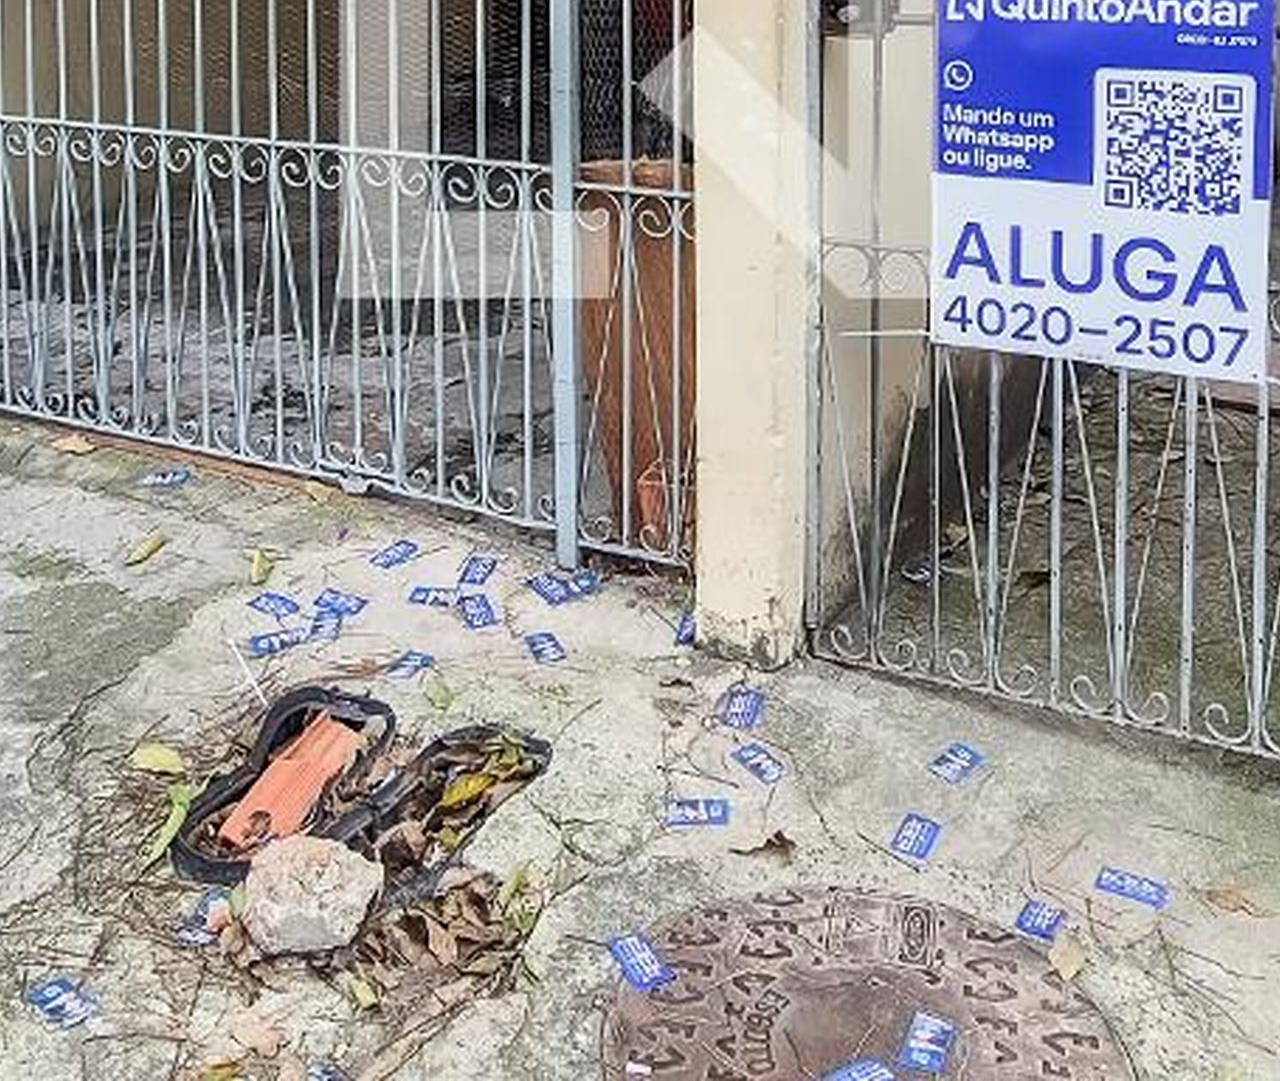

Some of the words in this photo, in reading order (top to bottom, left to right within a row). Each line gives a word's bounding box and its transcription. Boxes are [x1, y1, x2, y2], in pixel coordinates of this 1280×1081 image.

[943, 103, 1015, 126] Mande
[1019, 110, 1055, 128] um
[943, 125, 1055, 154] Whatsapp
[943, 150, 971, 167] ou
[973, 148, 1032, 173] ligue.
[945, 221, 1249, 314] ALUGA
[943, 294, 1250, 368] 4020-2507
